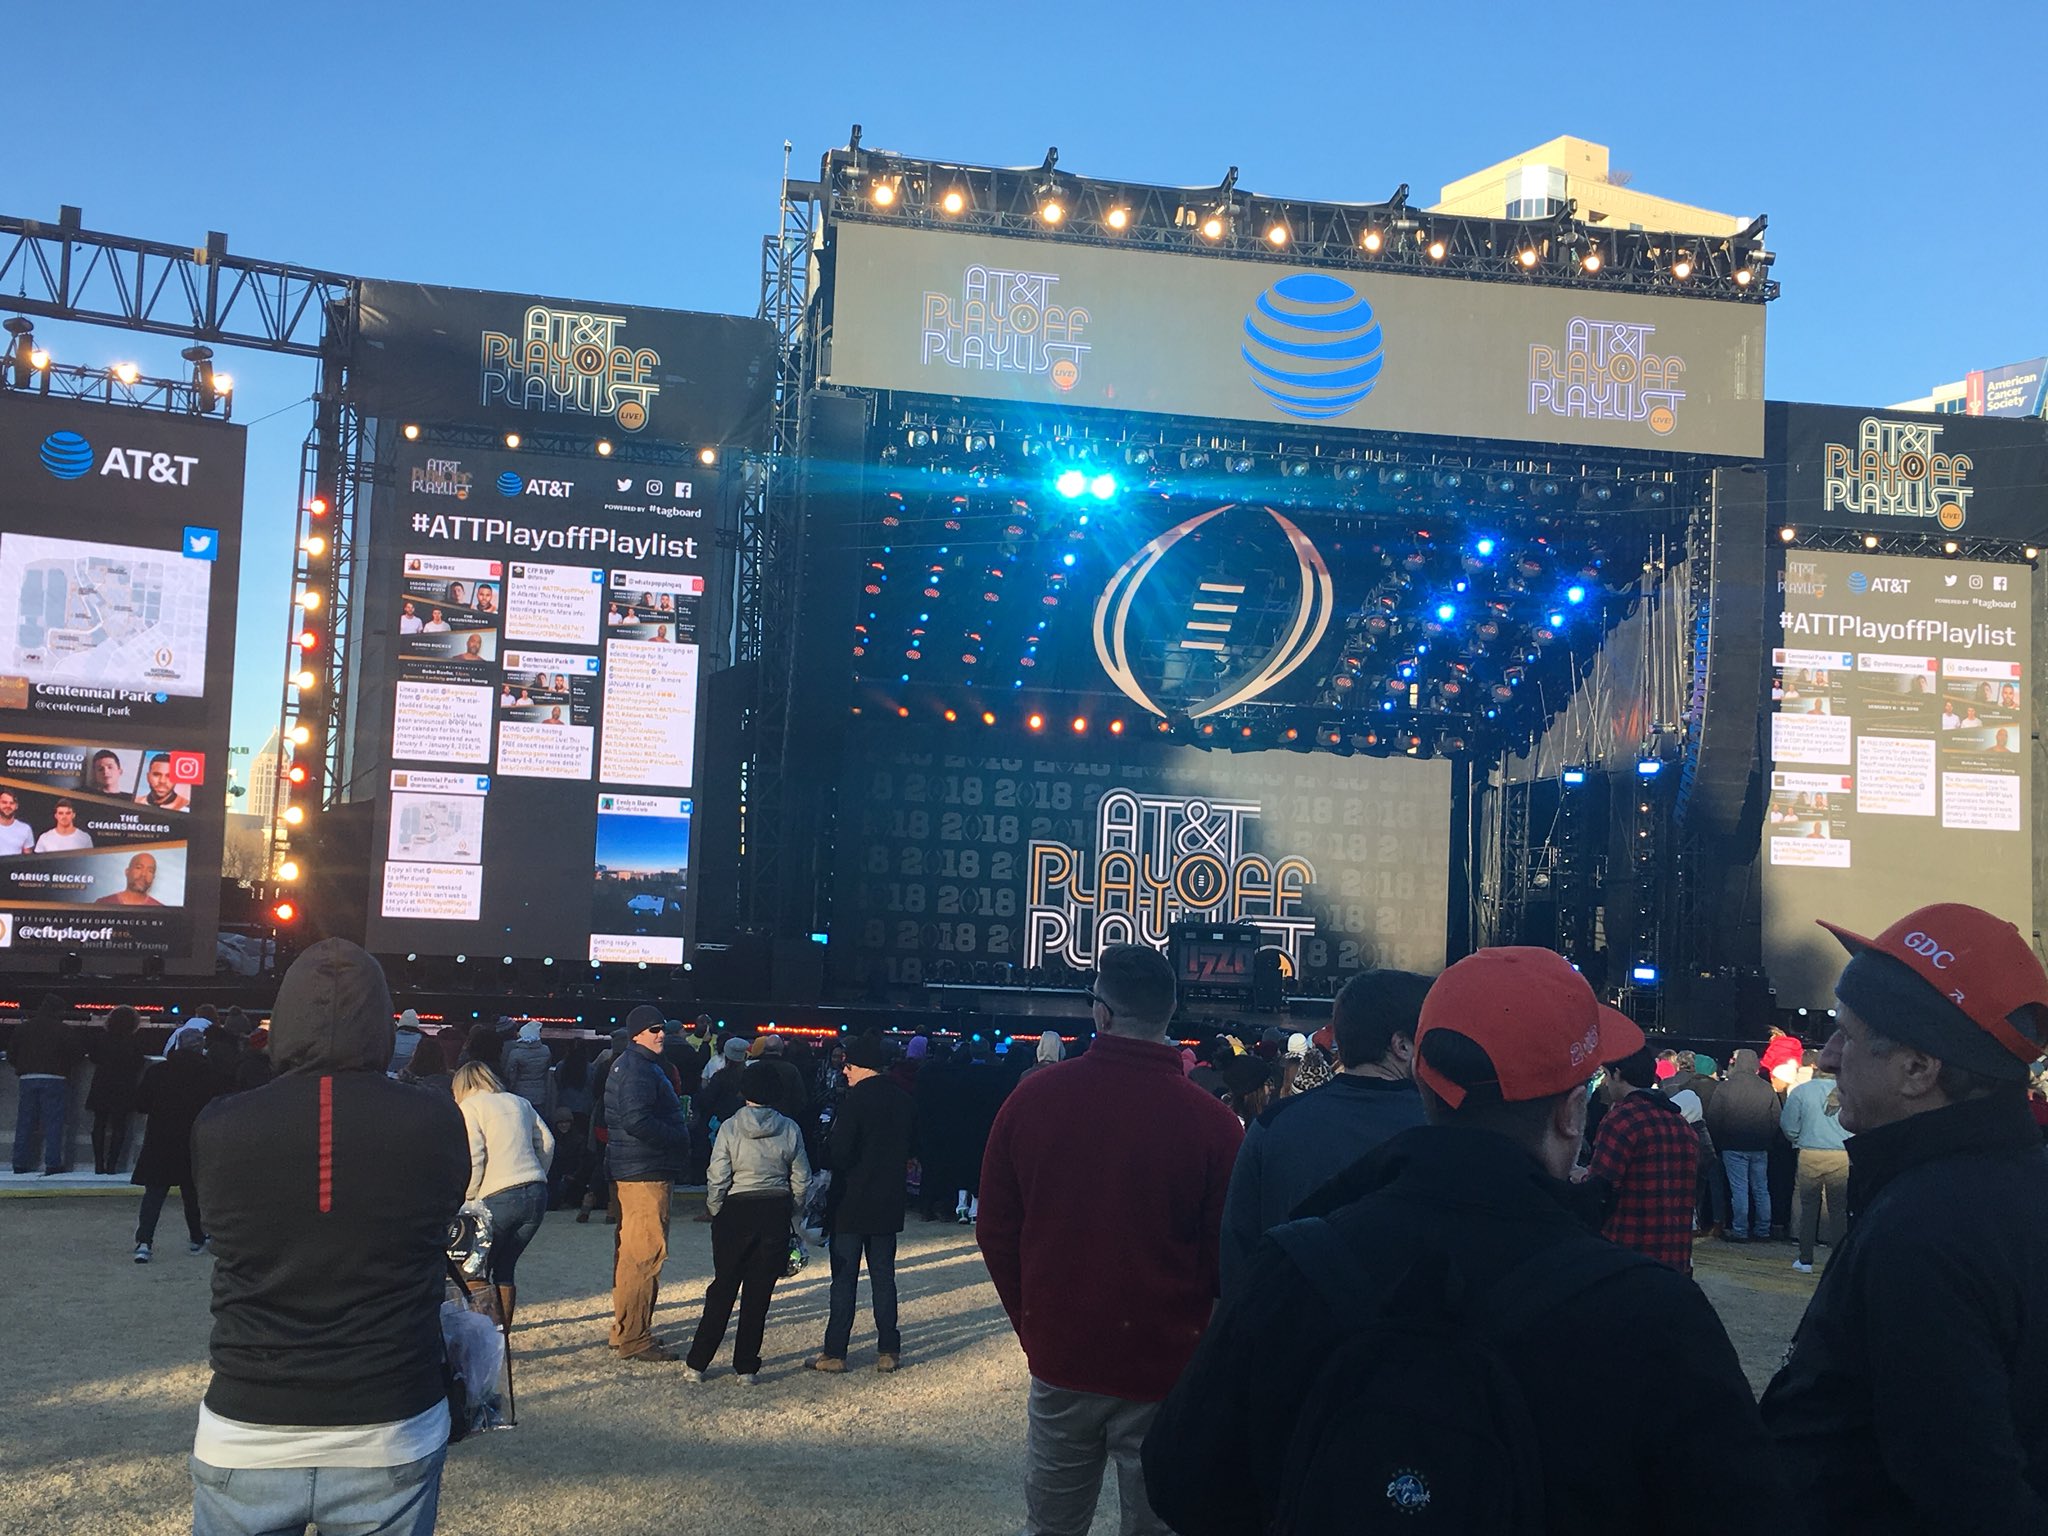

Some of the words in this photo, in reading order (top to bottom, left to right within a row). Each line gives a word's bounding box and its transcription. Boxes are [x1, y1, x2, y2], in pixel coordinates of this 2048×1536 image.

[963, 263, 1060, 311] AT&T
[922, 290, 1092, 341] PLAYOFF
[524, 305, 627, 352] AT&T
[1566, 315, 1656, 360] AT&T
[482, 331, 661, 387] PLAYOFF
[921, 328, 1092, 375] PLAYLIST
[1054, 369, 1076, 379] LIVE!
[1529, 344, 1686, 391] PLAYOFF
[1987, 373, 2037, 392] American
[479, 370, 660, 417] PLAYLIST
[1528, 380, 1686, 421] PLAYLIST
[1987, 386, 2023, 401] Cancer
[1987, 397, 2025, 411] Society
[620, 410, 643, 422] LIVE!
[1653, 415, 1673, 425] LIVE!
[1859, 416, 1944, 457] AT&T
[100, 447, 199, 486] AT&T
[1824, 442, 1973, 488] PLAYOFF
[412, 479, 472, 495] PLAYLIST
[525, 478, 575, 498] AT&T
[1824, 478, 1974, 517] PLAYLIST
[604, 503, 636, 513] POWERED
[649, 504, 702, 519] #tagboard
[1942, 512, 1961, 521] LIVE!
[412, 513, 698, 561] #ATTPlayoffPlaylist
[1871, 577, 1911, 594] AT&T
[1972, 598, 2017, 609] #tagboard
[1779, 611, 2016, 648] #ATTPlayoffPlaylist
[36, 682, 115, 701] Centennial
[119, 690, 153, 703] Park
[35, 700, 131, 717] @centennial_park
[6, 750, 41, 759] JASON
[43, 752, 85, 762] DERULO
[7, 758, 53, 768] CHARLIE
[54, 761, 83, 771] PUTH
[87, 821, 170, 833] CHAINSMOKERS
[120, 814, 140, 823] THE
[1100, 787, 1261, 860] AT&T
[10, 872, 50, 882] DARIUS
[52, 873, 94, 884] RUCKER
[1029, 839, 1317, 925] PLAYOFF
[18, 926, 114, 942] @cfbplayoff
[105, 940, 132, 950] Brett
[135, 941, 169, 952] Young
[1903, 931, 1956, 969] GDC
